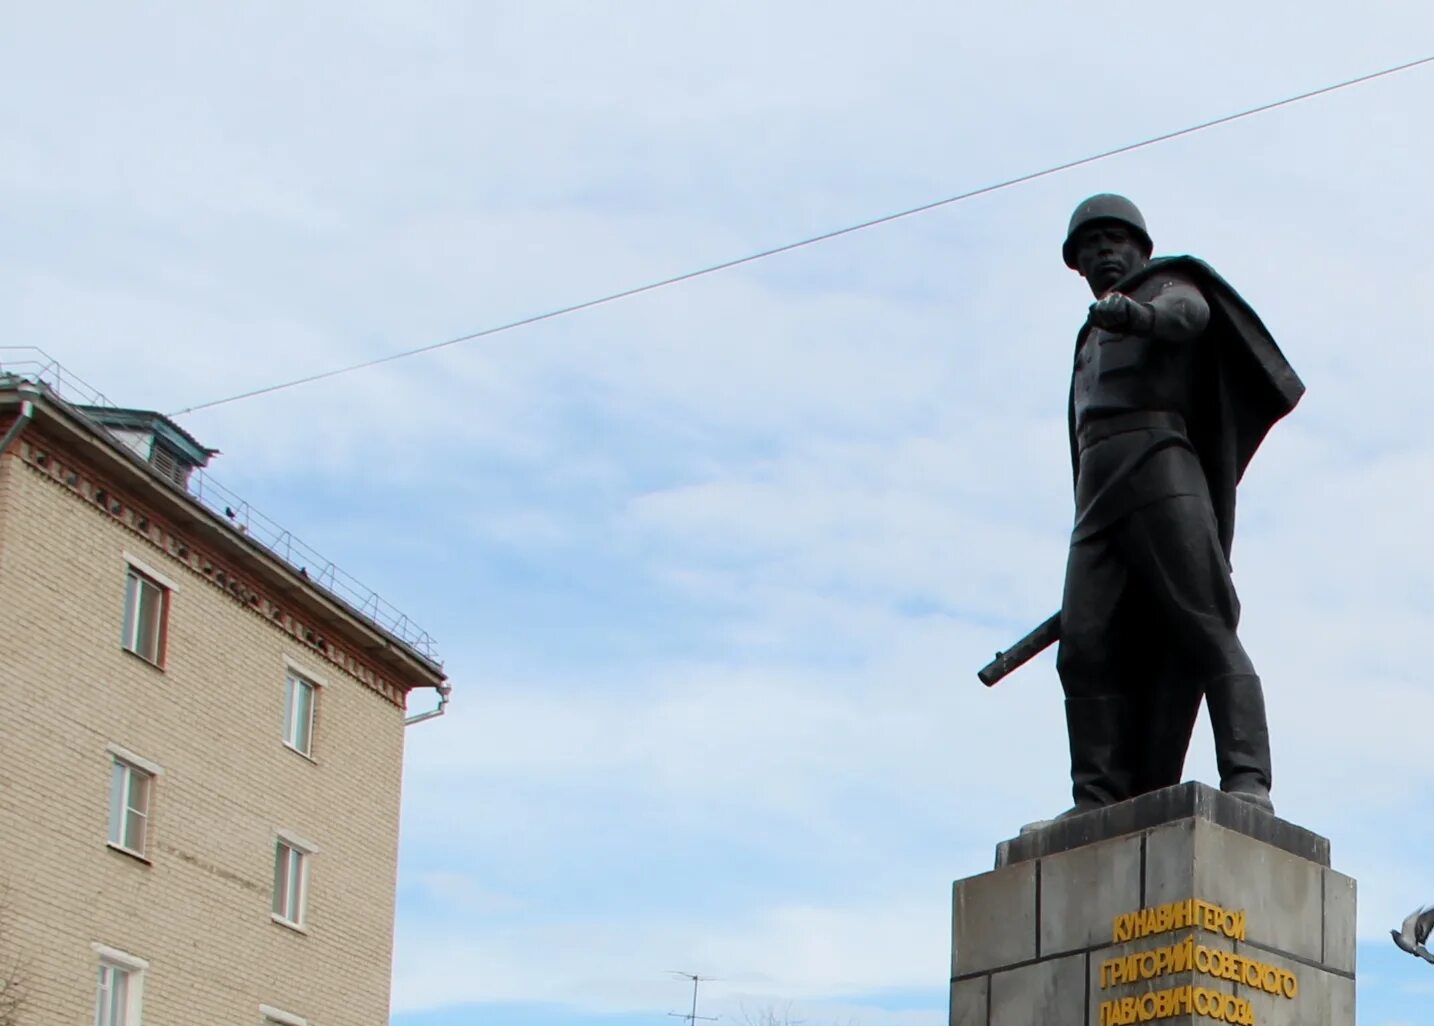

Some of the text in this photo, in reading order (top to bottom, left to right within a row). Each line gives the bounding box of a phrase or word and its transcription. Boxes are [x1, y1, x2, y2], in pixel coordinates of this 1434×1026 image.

[1113, 898, 1192, 943] КУНАВИН
[1101, 934, 1193, 989] ГРИГОРИЙ
[1194, 945, 1298, 999] СОВЕТСКОГО
